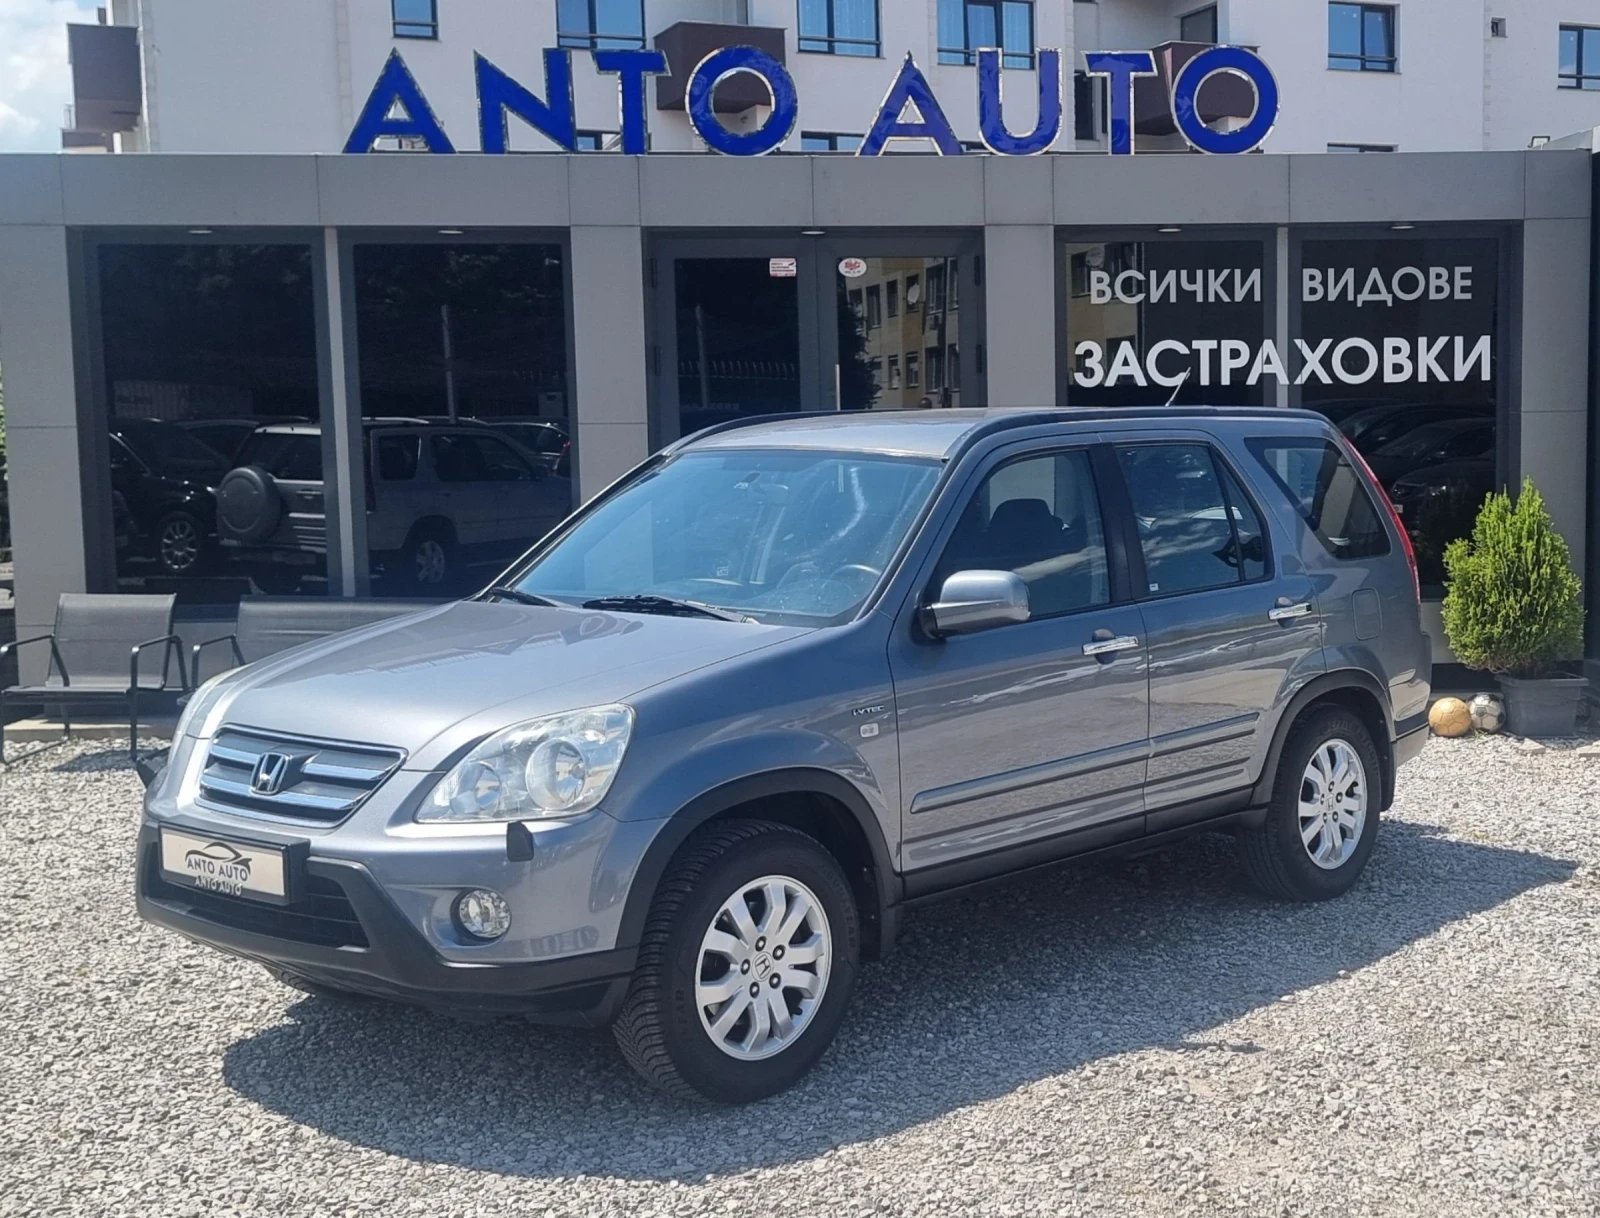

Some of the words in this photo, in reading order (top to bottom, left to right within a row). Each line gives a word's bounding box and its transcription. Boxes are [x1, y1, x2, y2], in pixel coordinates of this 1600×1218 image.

[341, 44, 799, 157] ANTO
[855, 43, 1281, 157] AUTO
[1090, 268, 1262, 305] ВСИЧКИ
[1302, 266, 1473, 307] ВИДОВЕ
[1073, 335, 1492, 388] ЗАСТРАХОВКИ
[187, 858, 215, 875] ANTO
[219, 864, 248, 882] AUTO
[195, 875, 217, 890] ANTO
[219, 881, 242, 896] AUTO
